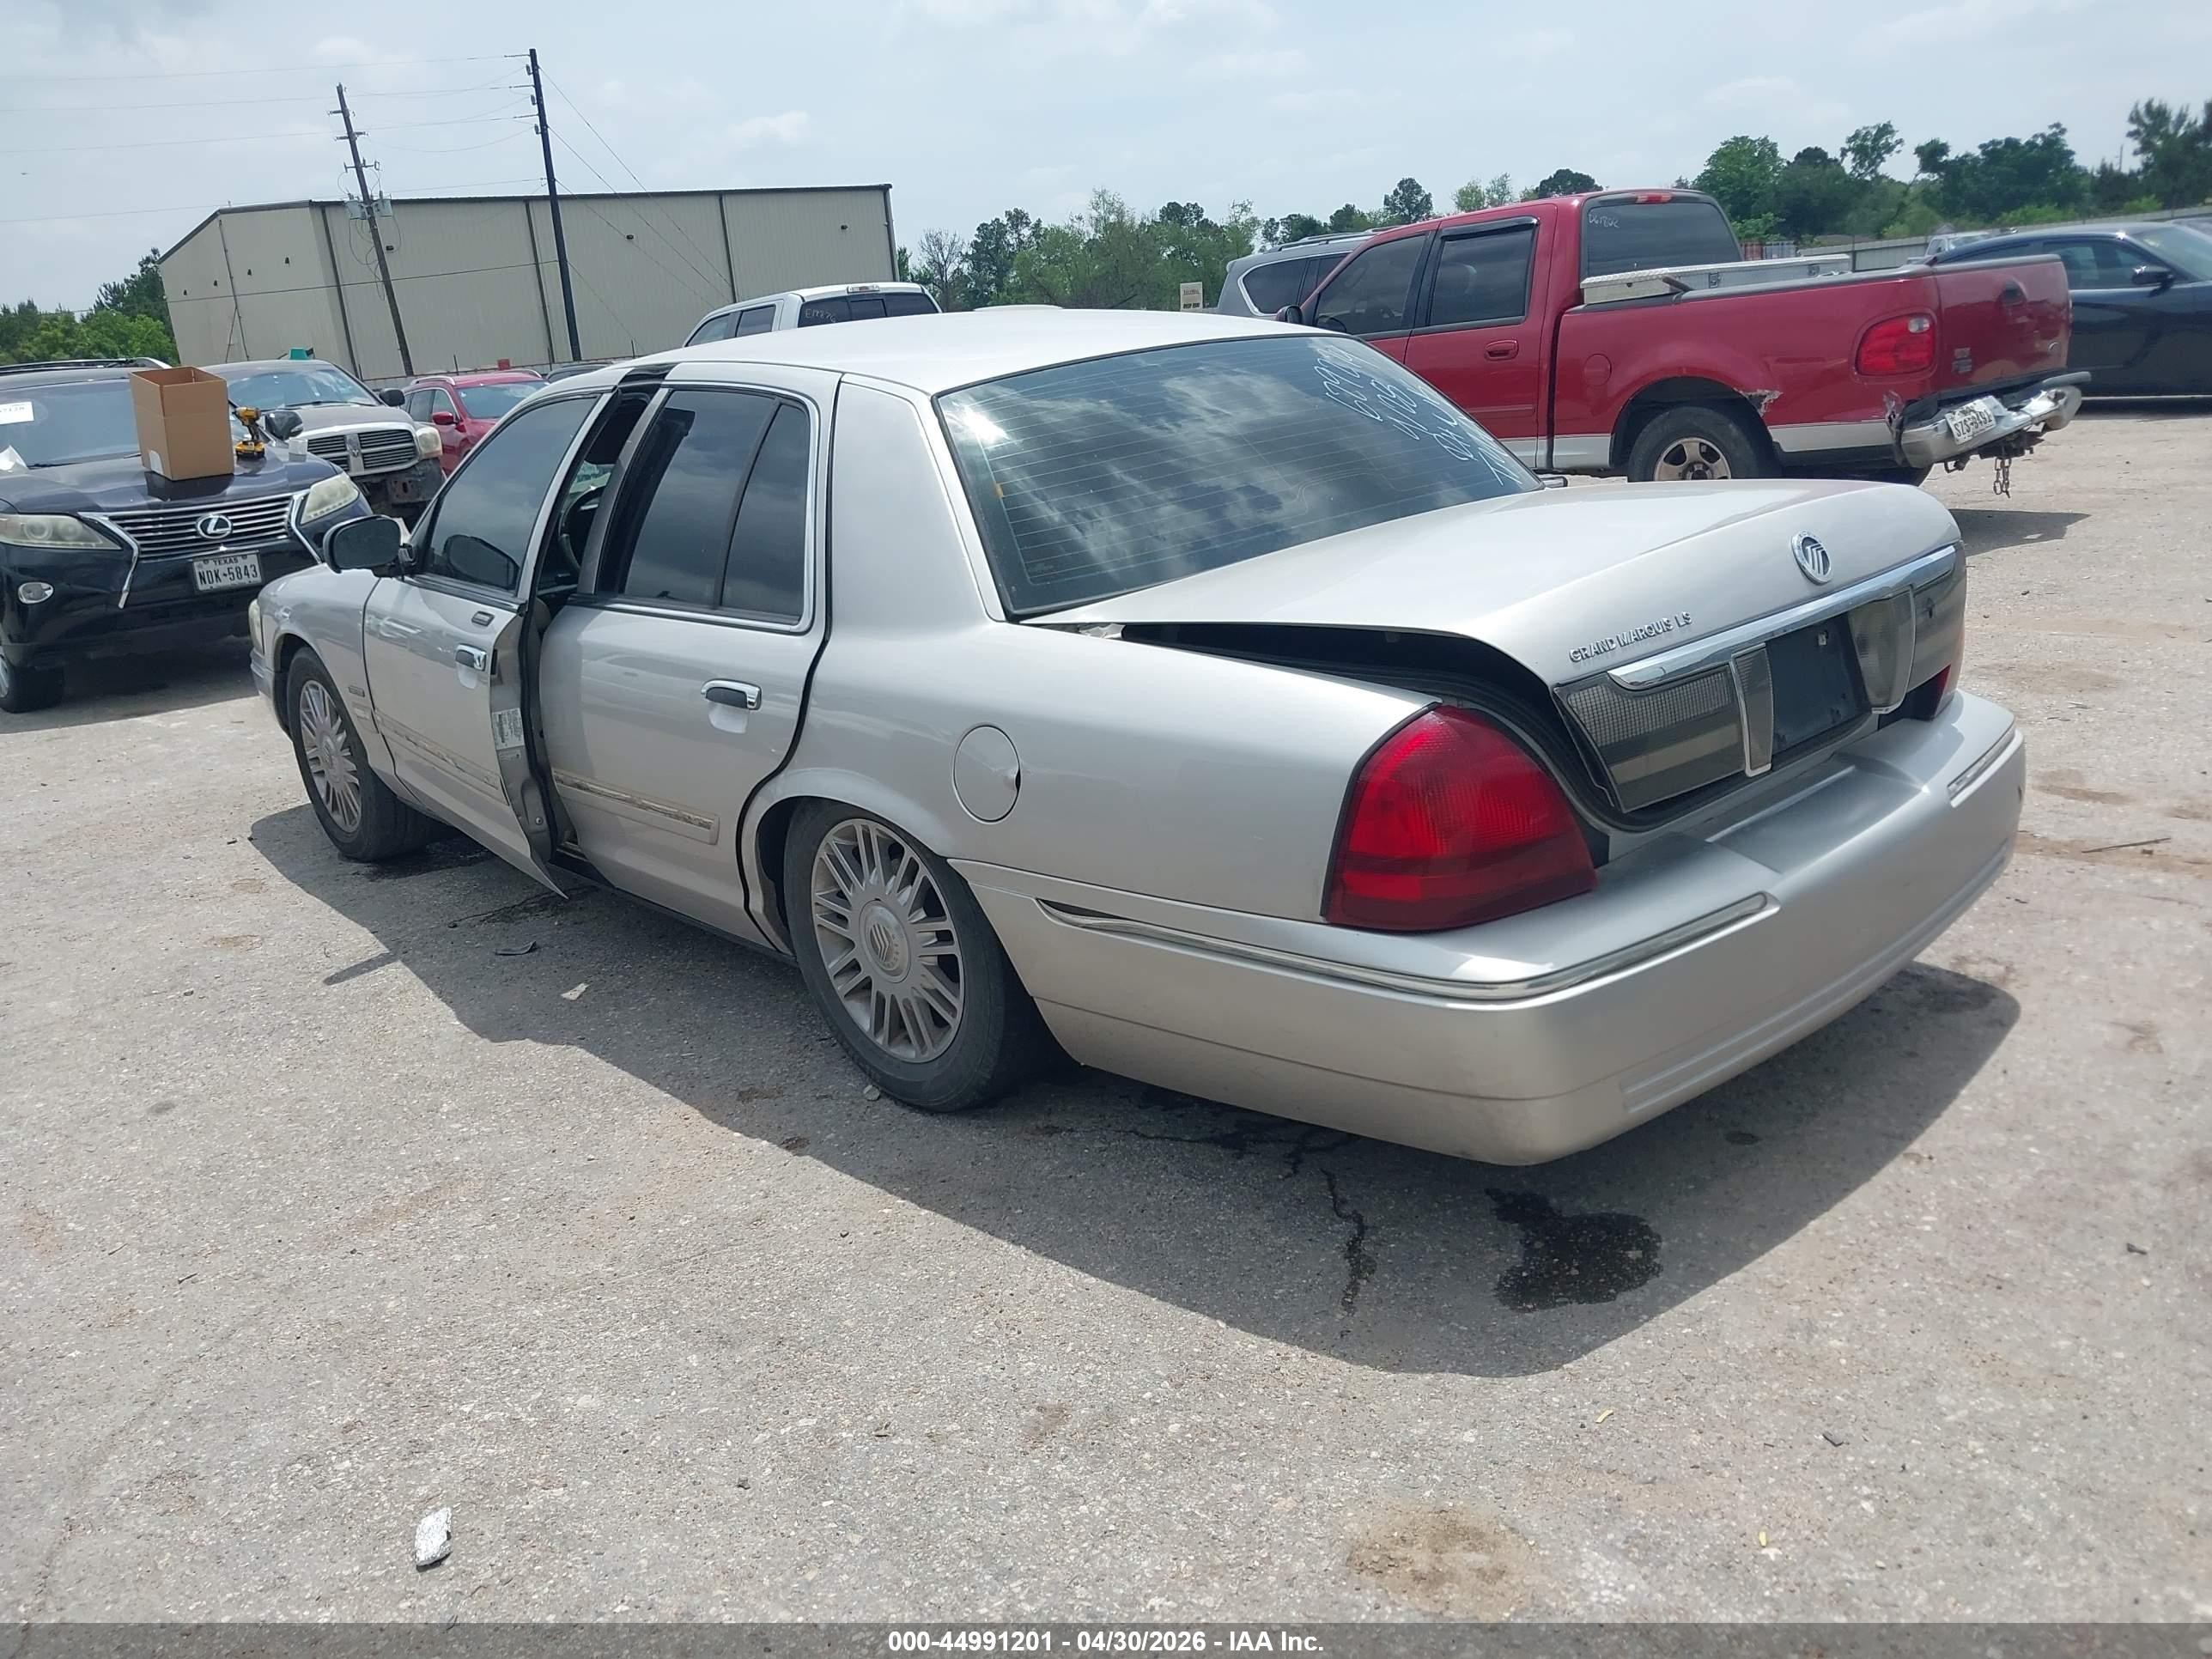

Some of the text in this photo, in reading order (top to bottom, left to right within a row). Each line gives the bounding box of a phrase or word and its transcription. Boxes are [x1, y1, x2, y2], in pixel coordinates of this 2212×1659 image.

[213, 556, 239, 566] TEXAS
[1569, 611, 1692, 663] GRAND MARQUIS LS
